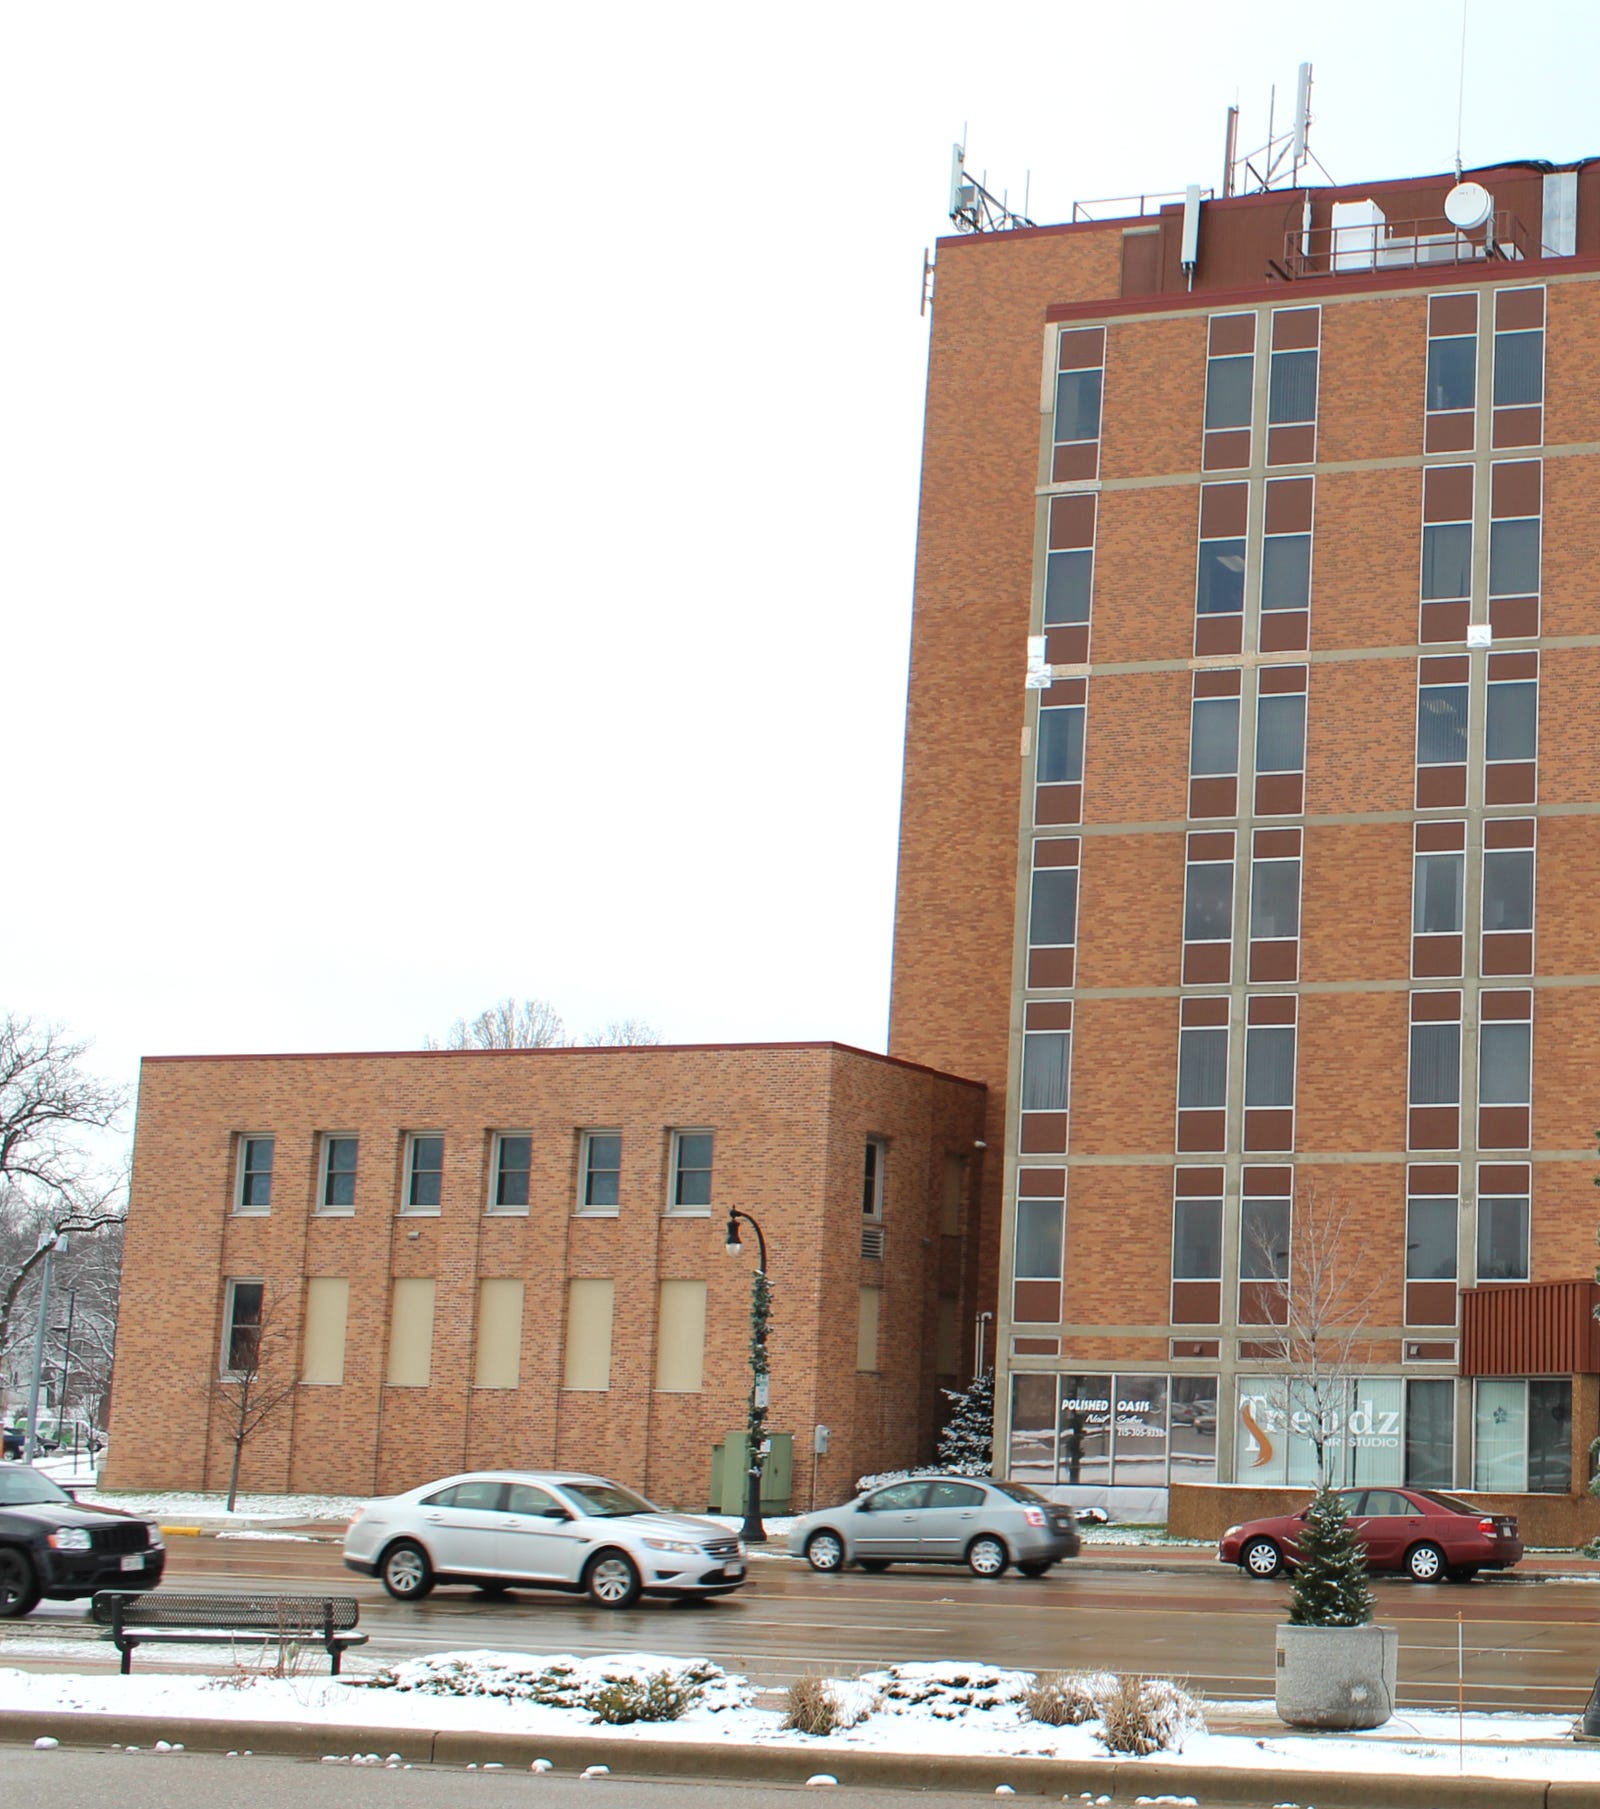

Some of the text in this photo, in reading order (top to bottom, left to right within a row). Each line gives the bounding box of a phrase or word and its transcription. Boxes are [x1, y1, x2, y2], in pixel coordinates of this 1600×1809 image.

[1061, 1399, 1150, 1413] POLISHED OASIS
[1239, 1393, 1400, 1452] Trendz
[1348, 1438, 1399, 1448] STUDIO
